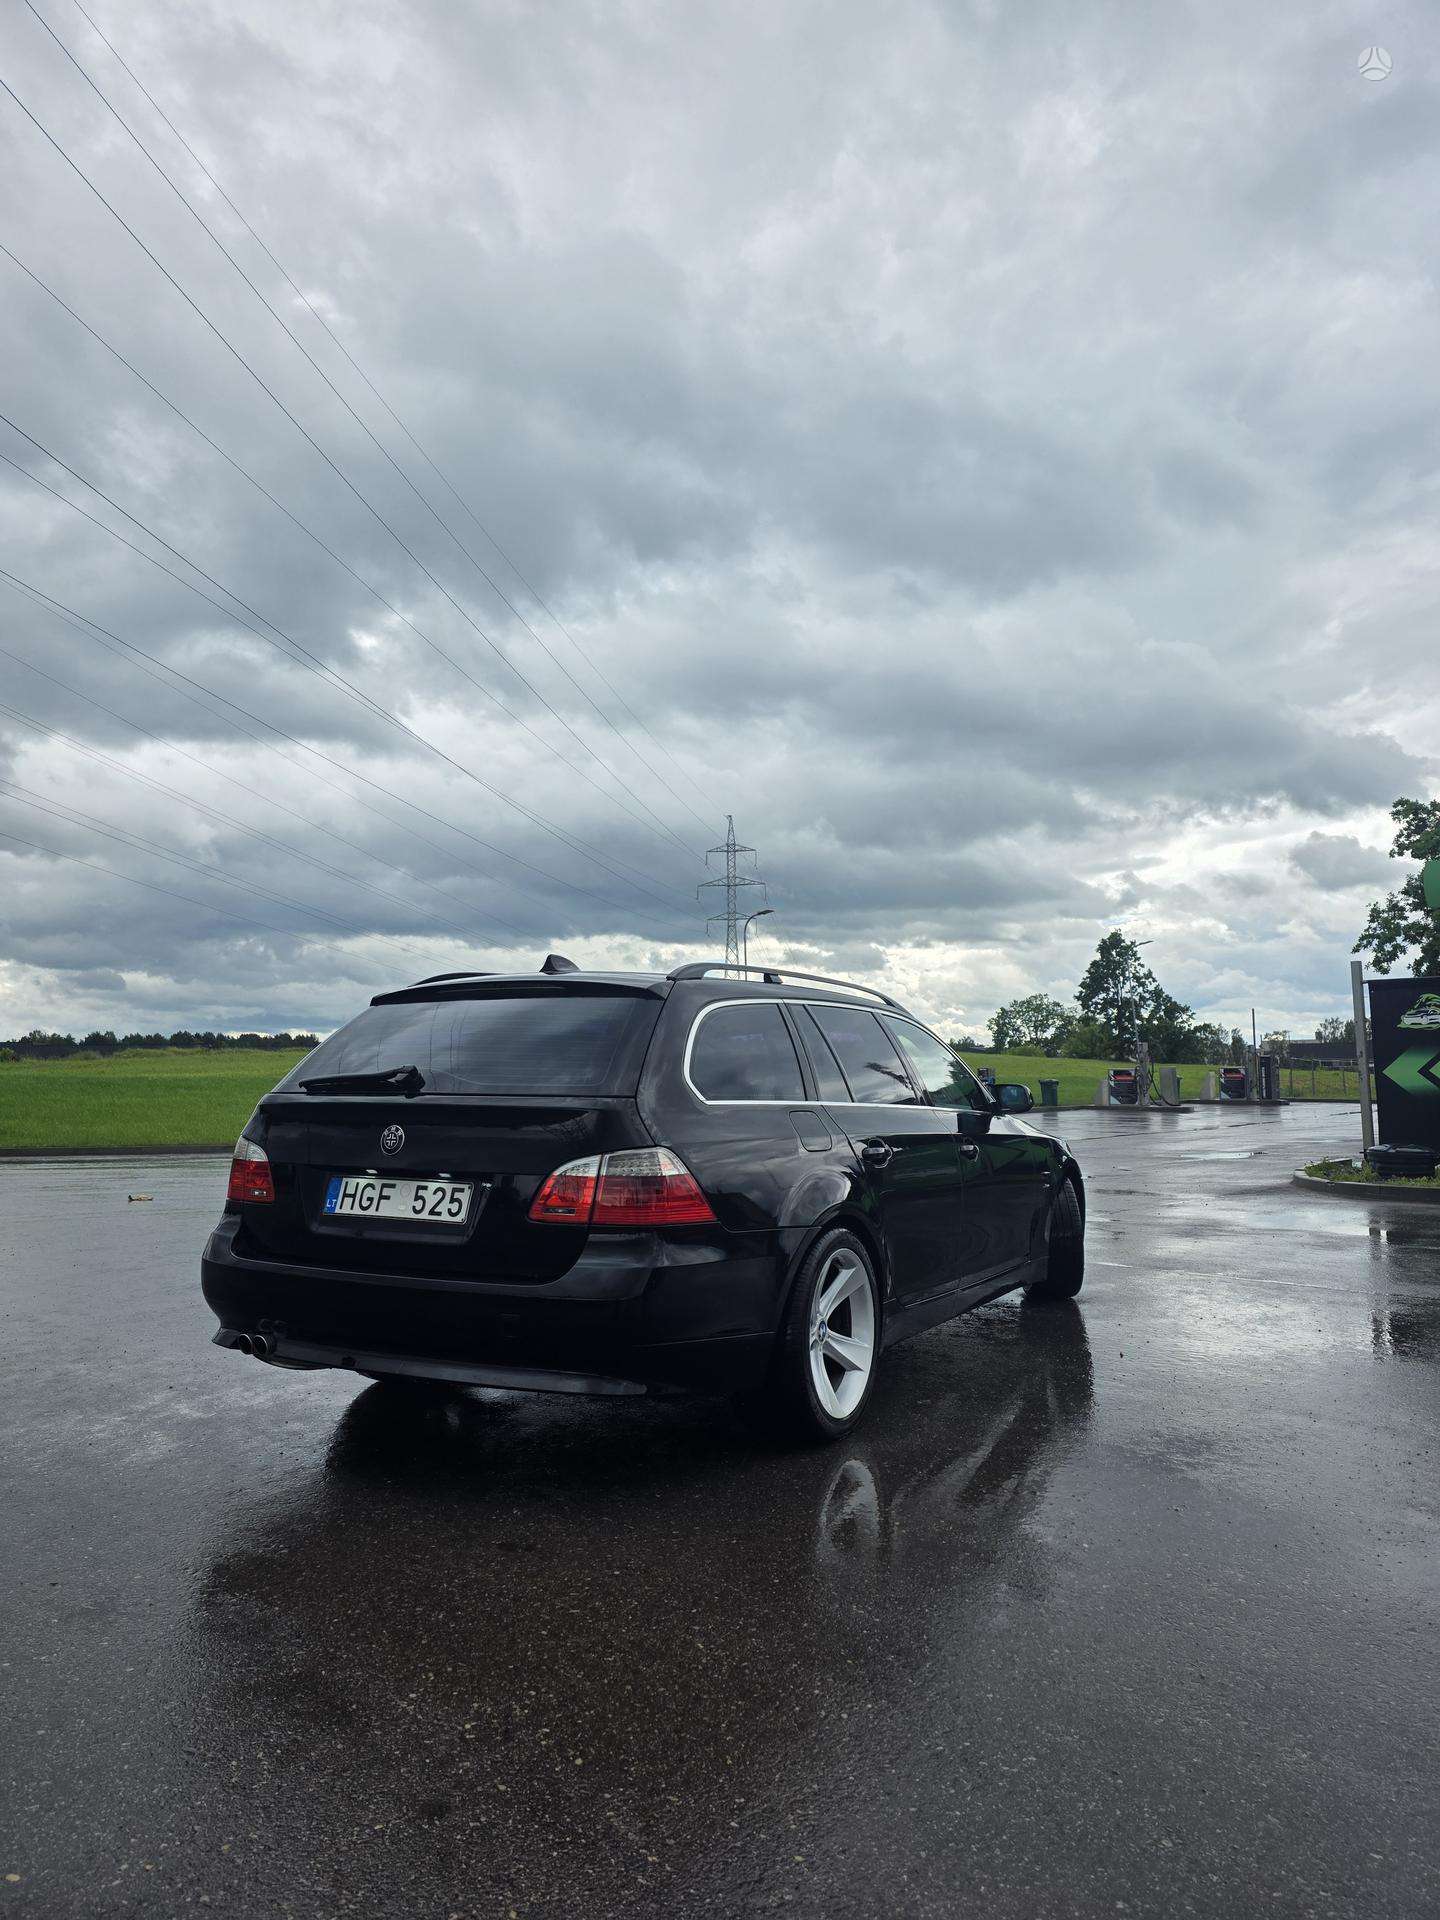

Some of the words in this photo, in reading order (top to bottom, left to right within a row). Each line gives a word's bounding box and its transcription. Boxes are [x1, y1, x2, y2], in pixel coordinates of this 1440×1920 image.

[326, 1198, 337, 1208] LT
[339, 1181, 396, 1212] HGF
[412, 1185, 466, 1218] 525
